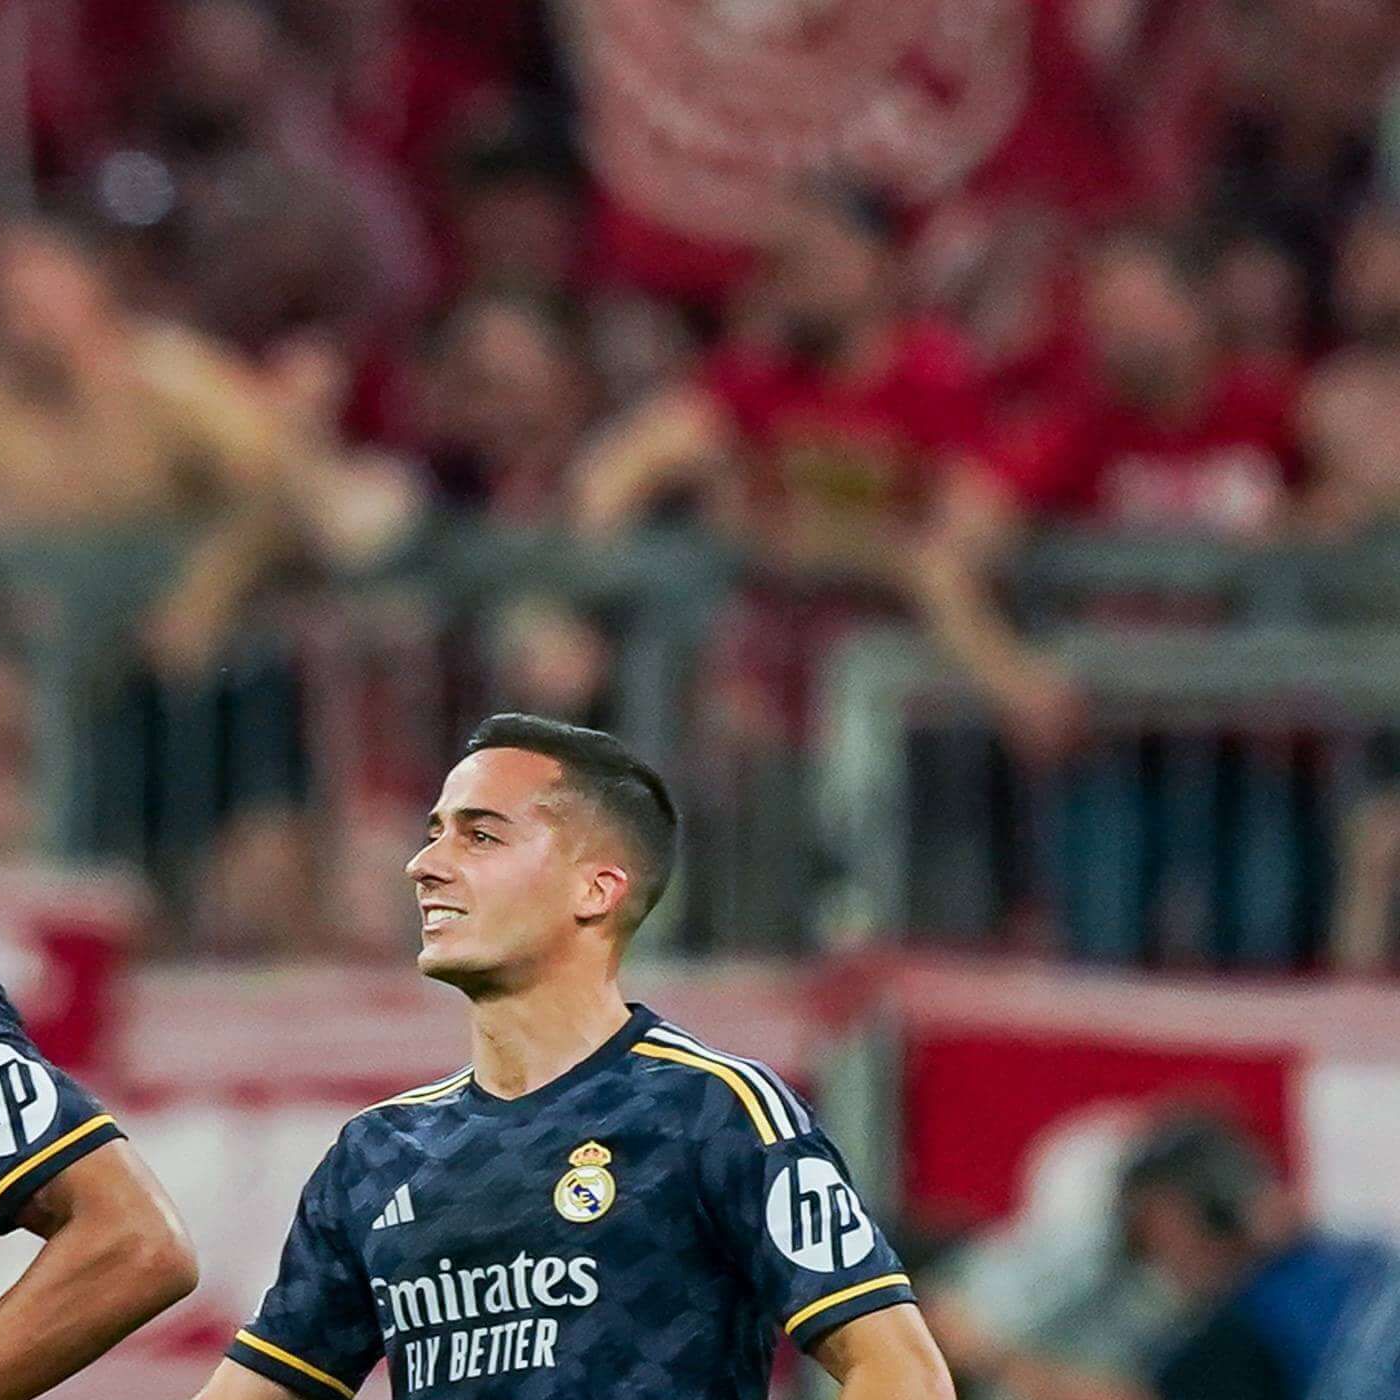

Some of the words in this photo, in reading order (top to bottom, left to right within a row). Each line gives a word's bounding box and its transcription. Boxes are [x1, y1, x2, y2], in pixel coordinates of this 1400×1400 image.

[783, 1158, 864, 1273] hp
[404, 1335, 441, 1393] FLY
[448, 1318, 559, 1382] BETTER
